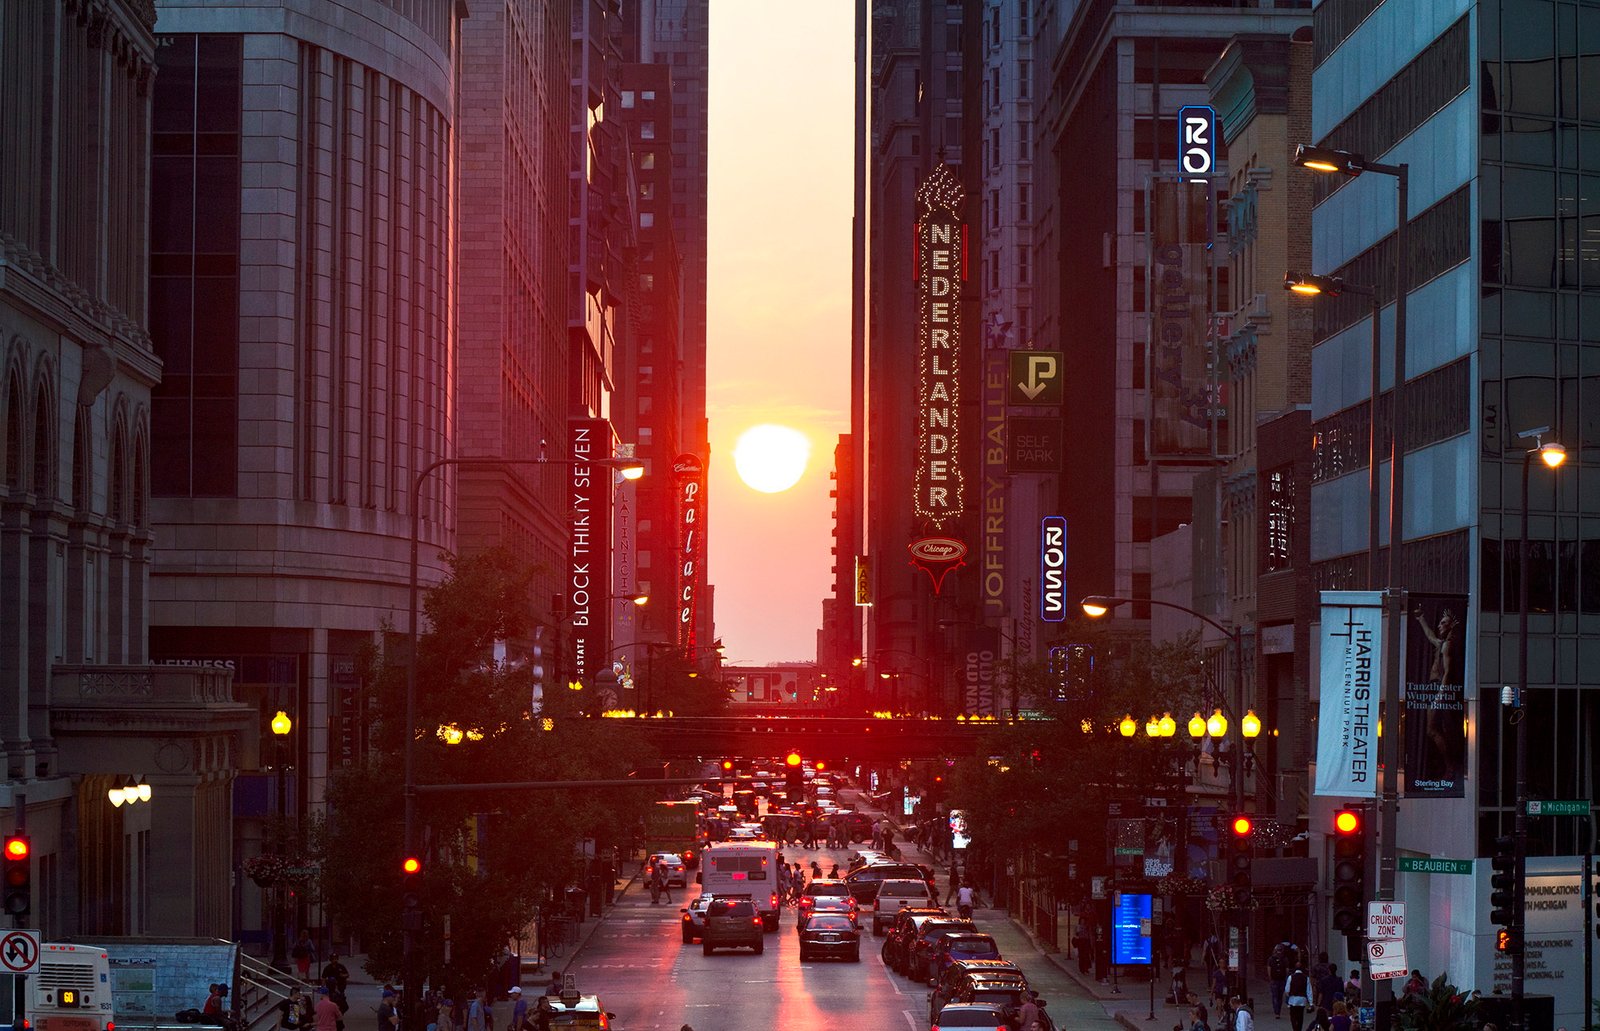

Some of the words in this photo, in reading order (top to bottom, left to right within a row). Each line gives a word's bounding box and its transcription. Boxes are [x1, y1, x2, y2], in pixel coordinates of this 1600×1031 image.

[1183, 118, 1211, 183] RO
[1156, 245, 1190, 389] gallery
[930, 223, 950, 507] NEDERLANDER
[987, 361, 1005, 465] BALLET
[1016, 435, 1049, 448] SELF
[1016, 450, 1054, 462] PARK
[575, 428, 590, 488] SEVEN
[574, 493, 590, 557] THIRTY
[619, 491, 630, 611] LATINICITY
[681, 482, 699, 623] Palace
[923, 544, 953, 556] Chicago
[985, 476, 1004, 609] JOFFREY
[1043, 526, 1064, 612] ROSS
[573, 562, 590, 626] BLOCK
[857, 565, 868, 603] ARK
[1018, 577, 1035, 655] Walgreens
[576, 638, 585, 666] STATE
[979, 650, 993, 681] OLD
[1354, 630, 1372, 701] HARRIS
[966, 652, 979, 682] OLD
[1343, 647, 1352, 715] MILLENNIUM
[966, 685, 978, 714] NAV
[979, 685, 993, 714] NAV
[1406, 682, 1463, 691] Tanztheater
[1406, 691, 1456, 701] Wuppertal
[1406, 701, 1428, 709] Pina
[1430, 701, 1463, 710] Bausch
[1342, 721, 1350, 747] PARK
[1351, 704, 1370, 783] THEATER
[1414, 779, 1440, 788] Sterling
[1440, 779, 1454, 788] Bay
[1547, 802, 1581, 814] Michigan
[1412, 860, 1457, 872] BEAUBIEN
[1524, 885, 1580, 896] MMUNICATIONS
[1534, 900, 1568, 910] MICHIGAN
[1370, 915, 1403, 925] CRUISING
[1382, 905, 1392, 914] NO
[1377, 926, 1396, 935] ZONE
[1554, 970, 1564, 978] LLC
[63, 991, 74, 1003] 60
